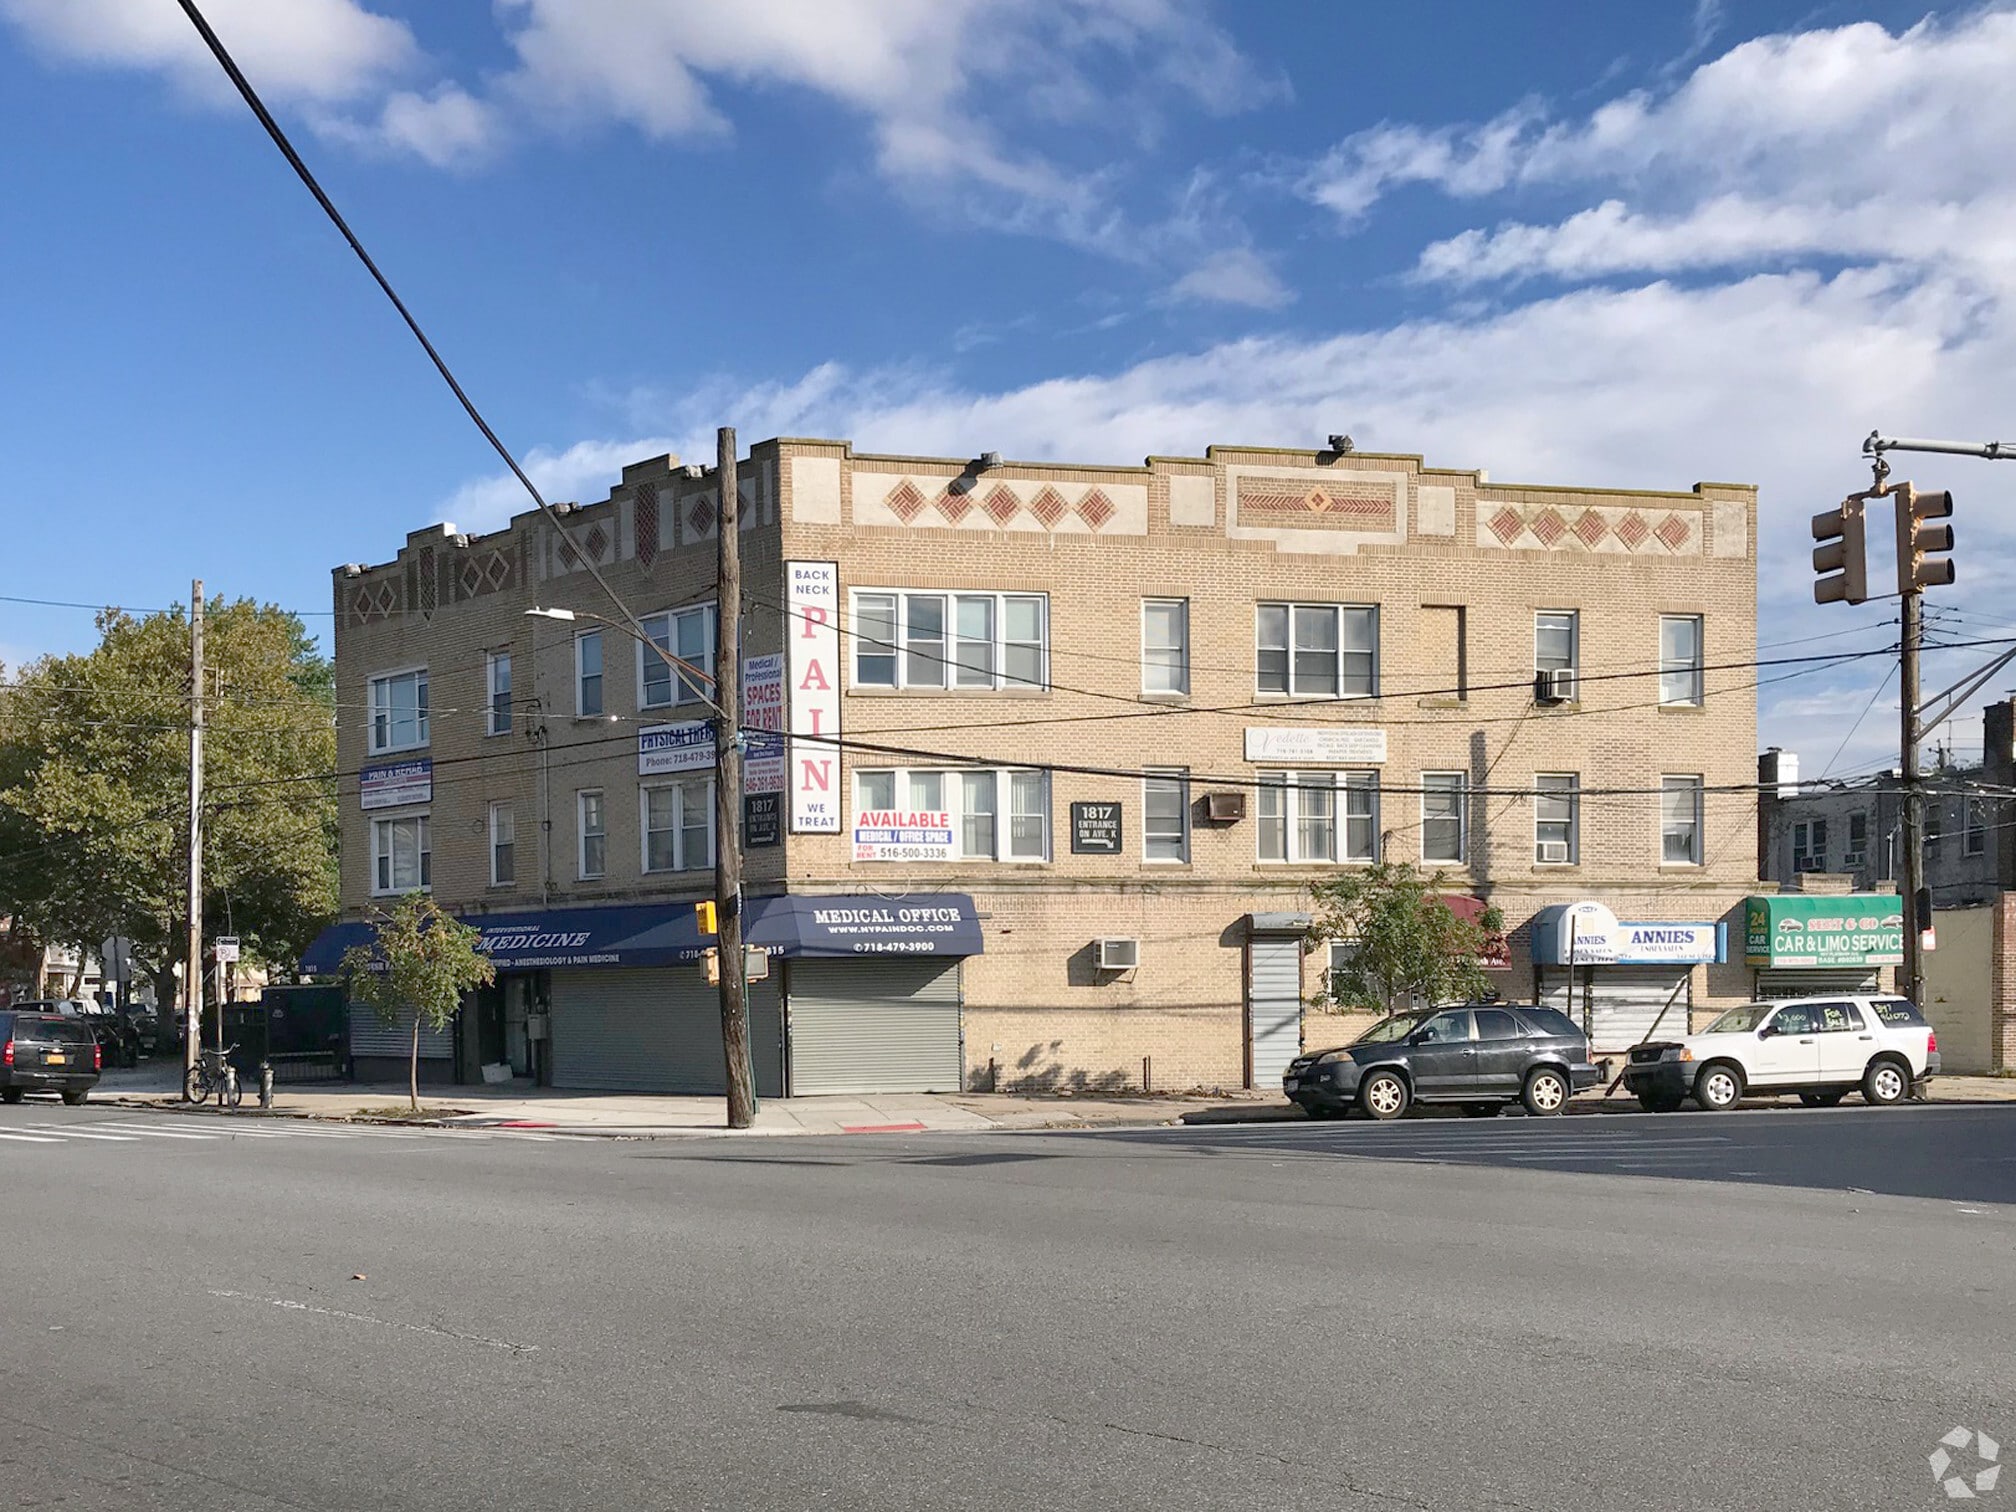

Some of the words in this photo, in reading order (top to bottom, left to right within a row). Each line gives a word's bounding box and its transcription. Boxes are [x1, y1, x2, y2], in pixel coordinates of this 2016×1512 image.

[795, 569, 829, 580] BACK
[796, 584, 830, 595] NECK
[749, 658, 774, 670] Medical
[745, 668, 782, 682] Professional
[746, 682, 781, 706] SPACES
[800, 606, 832, 791] PAIN
[746, 708, 760, 728] FOR
[763, 705, 782, 731] RENT
[641, 727, 686, 749] PHYSICAL
[646, 755, 672, 767] Phone:
[751, 799, 774, 813] 1817
[807, 803, 825, 813] WE
[1082, 806, 1113, 819] 1817
[798, 816, 835, 827] TREAT
[859, 812, 949, 828] AVAILABLE
[1078, 820, 1117, 829] ENTRANCE
[859, 831, 892, 842] MEDICAL
[899, 831, 924, 842] OFFICE
[925, 831, 948, 842] SPACE
[1079, 830, 1090, 838] ON
[1111, 830, 1117, 838] K
[880, 847, 947, 858] 516-500-3336
[813, 909, 894, 924] MEDICAL
[899, 908, 961, 922] OFFICE
[1750, 911, 1765, 926] 24
[486, 925, 541, 933] INTERVENTIONAL
[828, 924, 954, 933] WWW.NYPAINDOC.COM
[476, 932, 591, 950] MEDICINE
[1631, 930, 1695, 944] ANNIES
[1749, 935, 1766, 945] CAR
[1774, 935, 1804, 952] CAR
[1806, 935, 1816, 952] &
[1818, 934, 1850, 952] LIMO
[863, 942, 935, 952] 718-479-3900
[1746, 946, 1770, 954] SERVICE
[514, 956, 567, 966] ANESTHESIOLOGY
[573, 956, 588, 964] PAIN
[589, 954, 619, 963] MEDICINE
